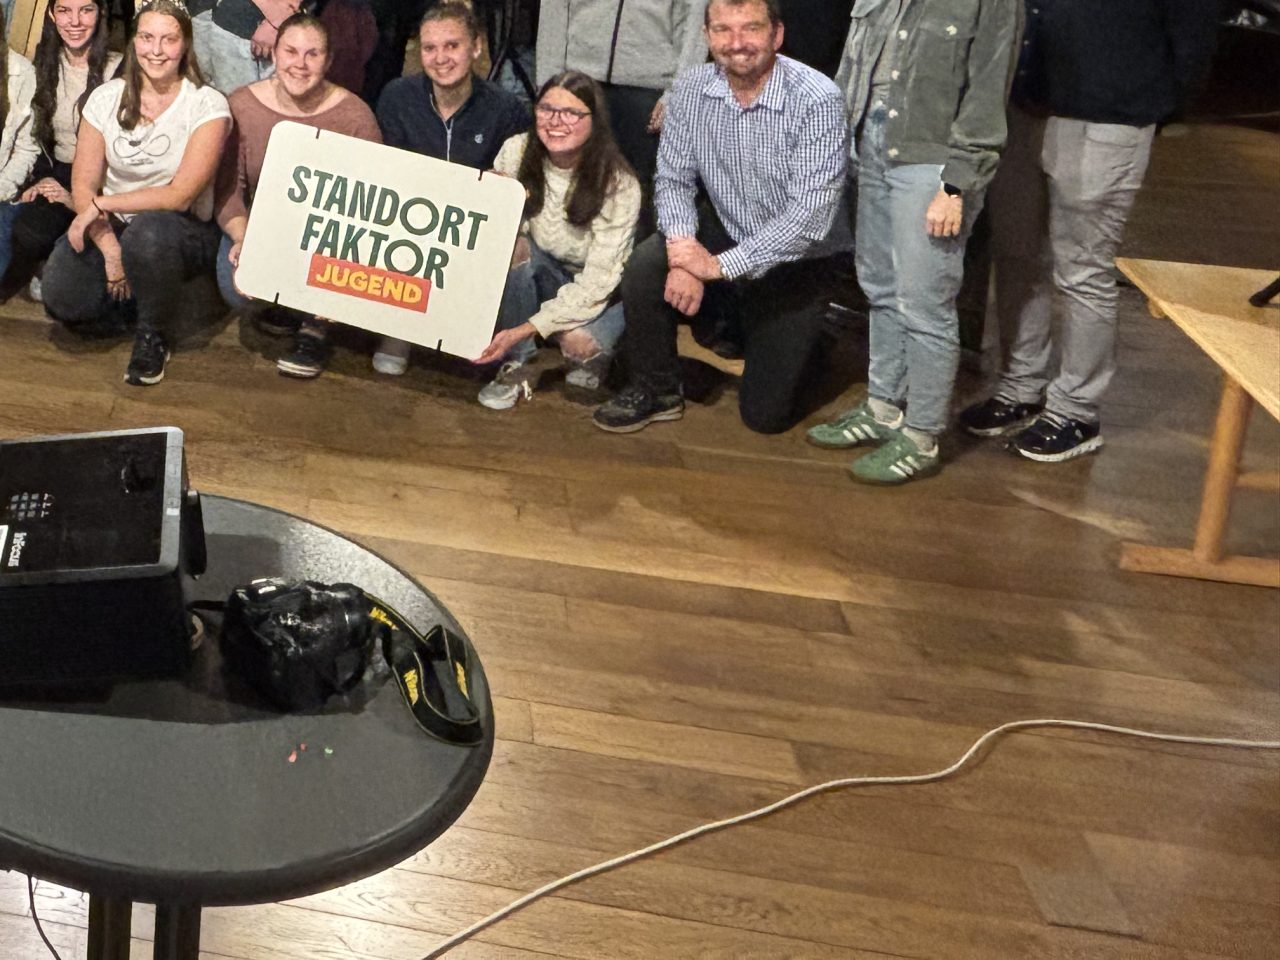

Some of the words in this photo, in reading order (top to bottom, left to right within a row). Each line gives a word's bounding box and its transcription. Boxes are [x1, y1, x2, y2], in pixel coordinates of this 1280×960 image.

[286, 165, 489, 251] STANDORT
[299, 212, 450, 290] FAKTOR
[315, 262, 423, 304] JUGEND
